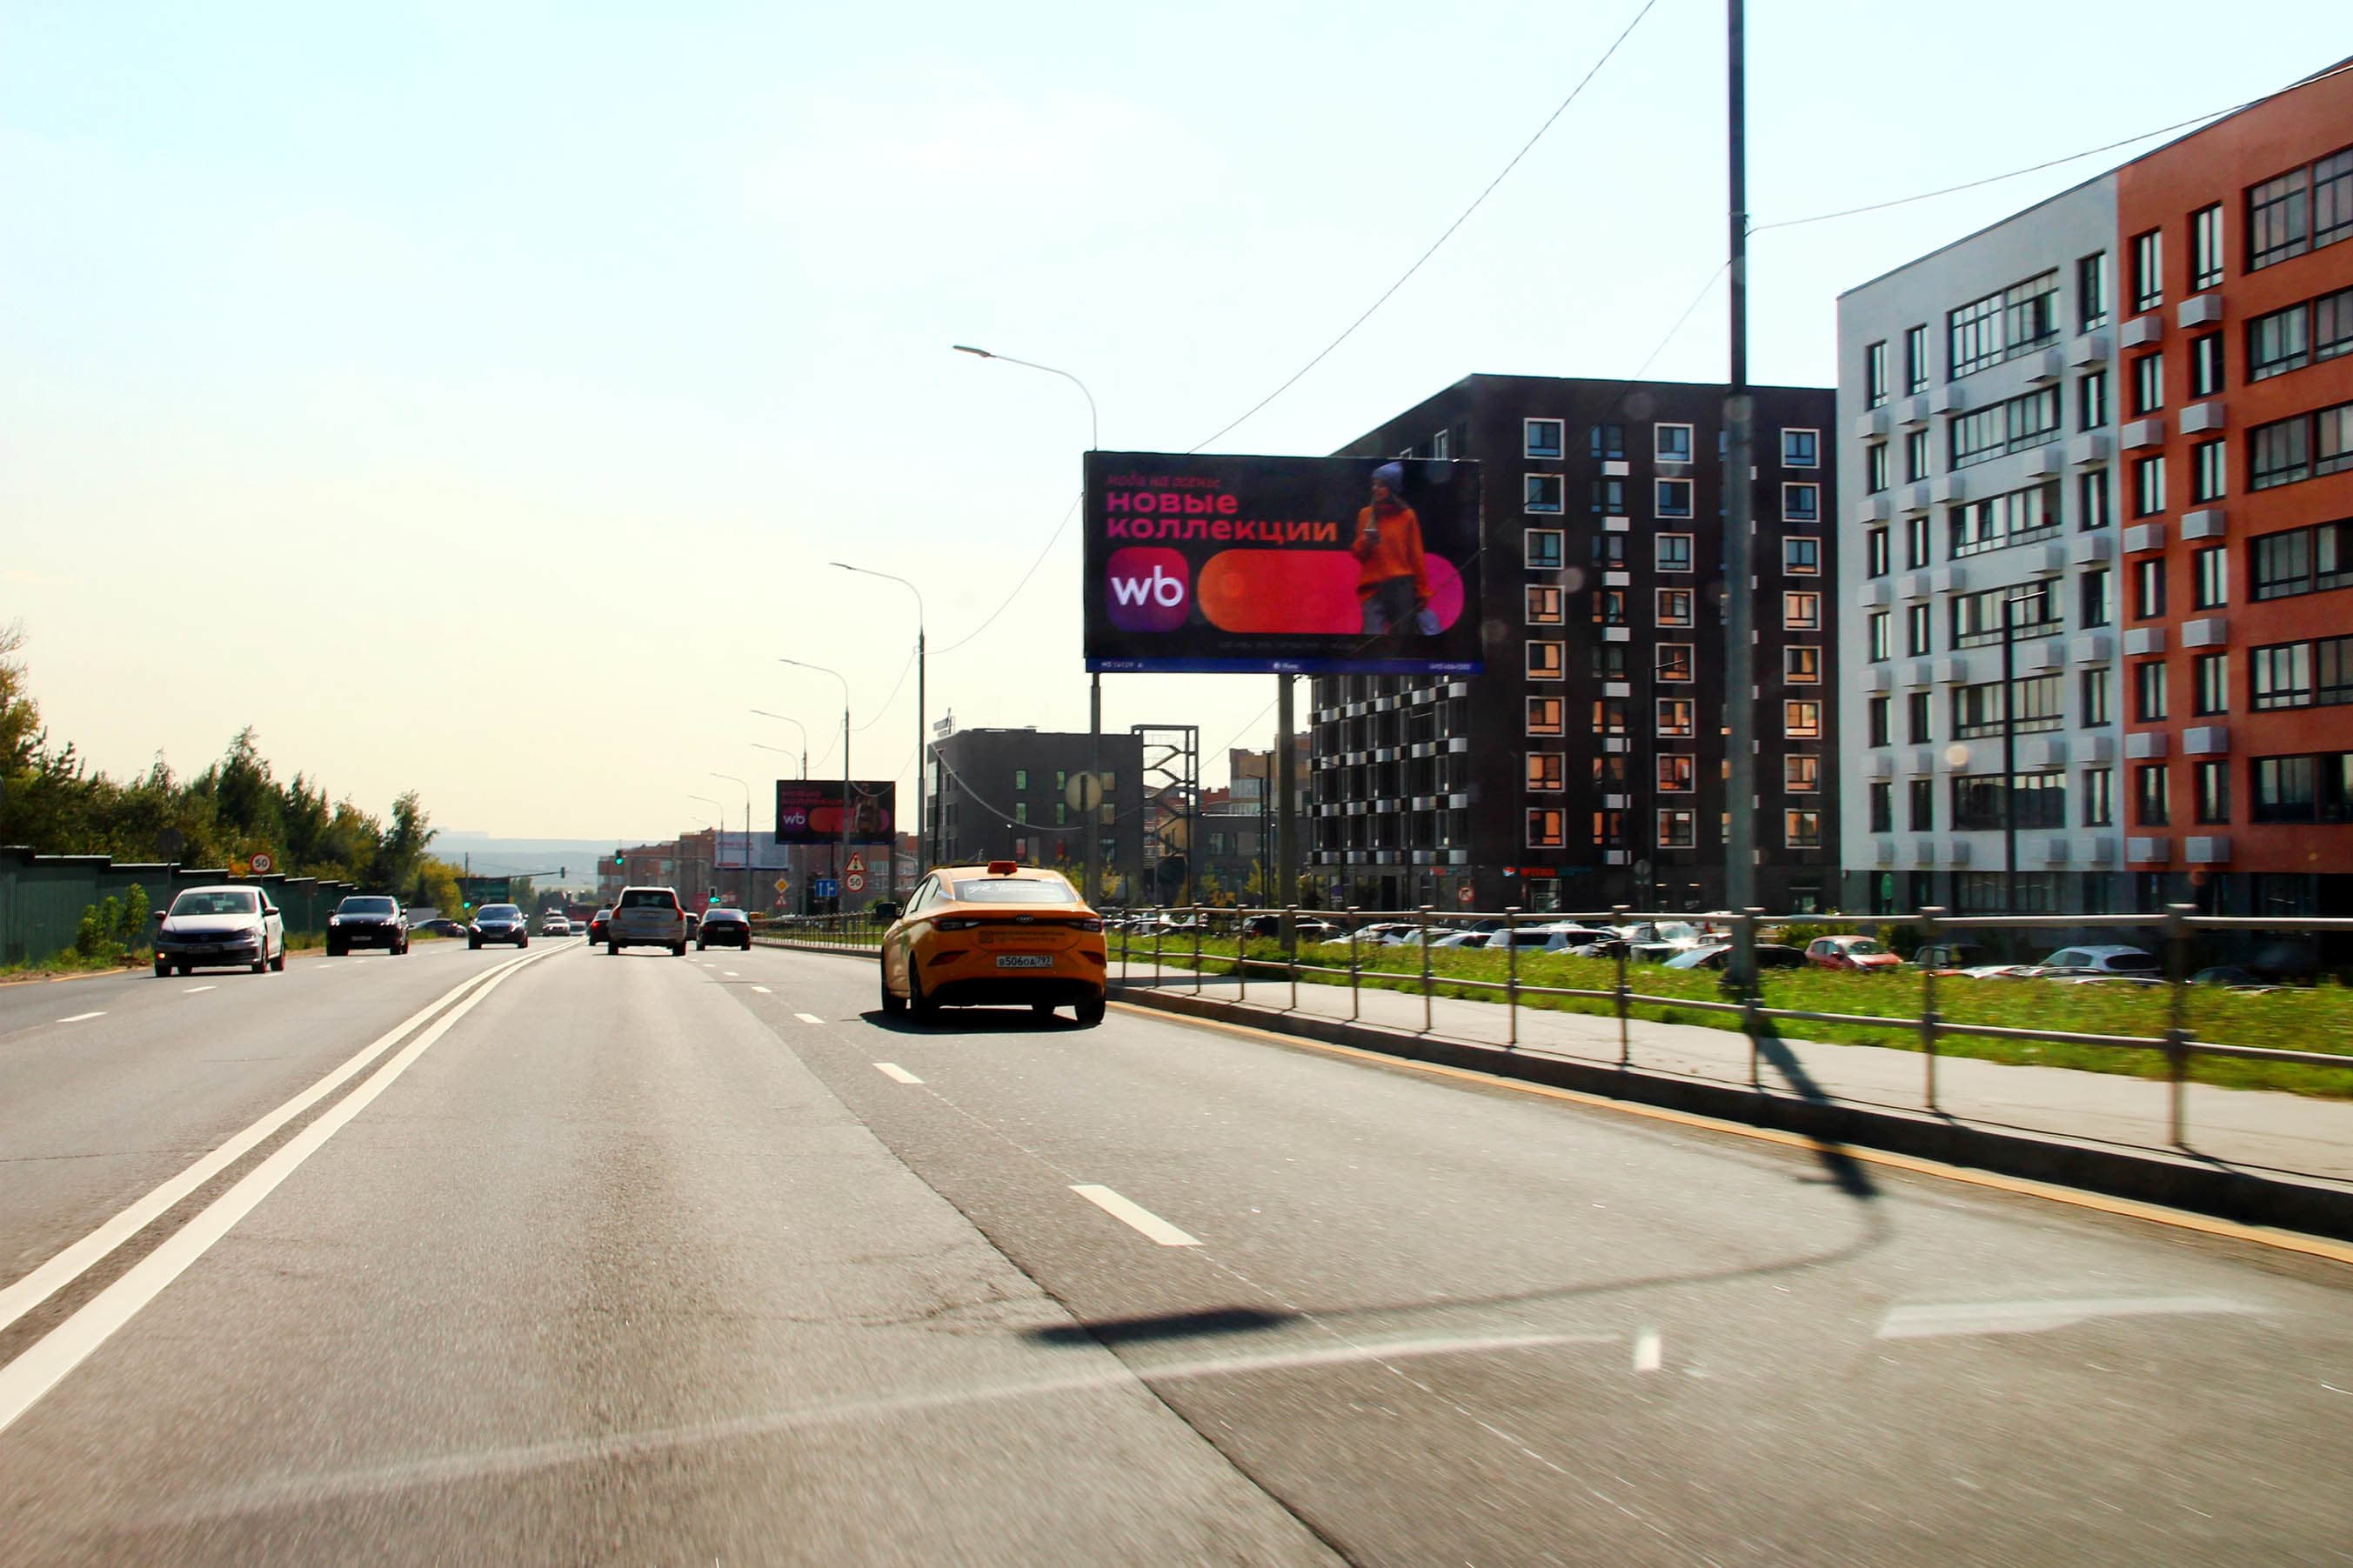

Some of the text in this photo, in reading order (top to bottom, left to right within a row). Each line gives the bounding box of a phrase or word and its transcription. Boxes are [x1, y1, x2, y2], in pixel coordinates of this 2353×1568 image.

[1111, 565, 1185, 607] wb
[783, 812, 806, 825] wb
[255, 858, 268, 867] 50
[849, 877, 861, 886] 50
